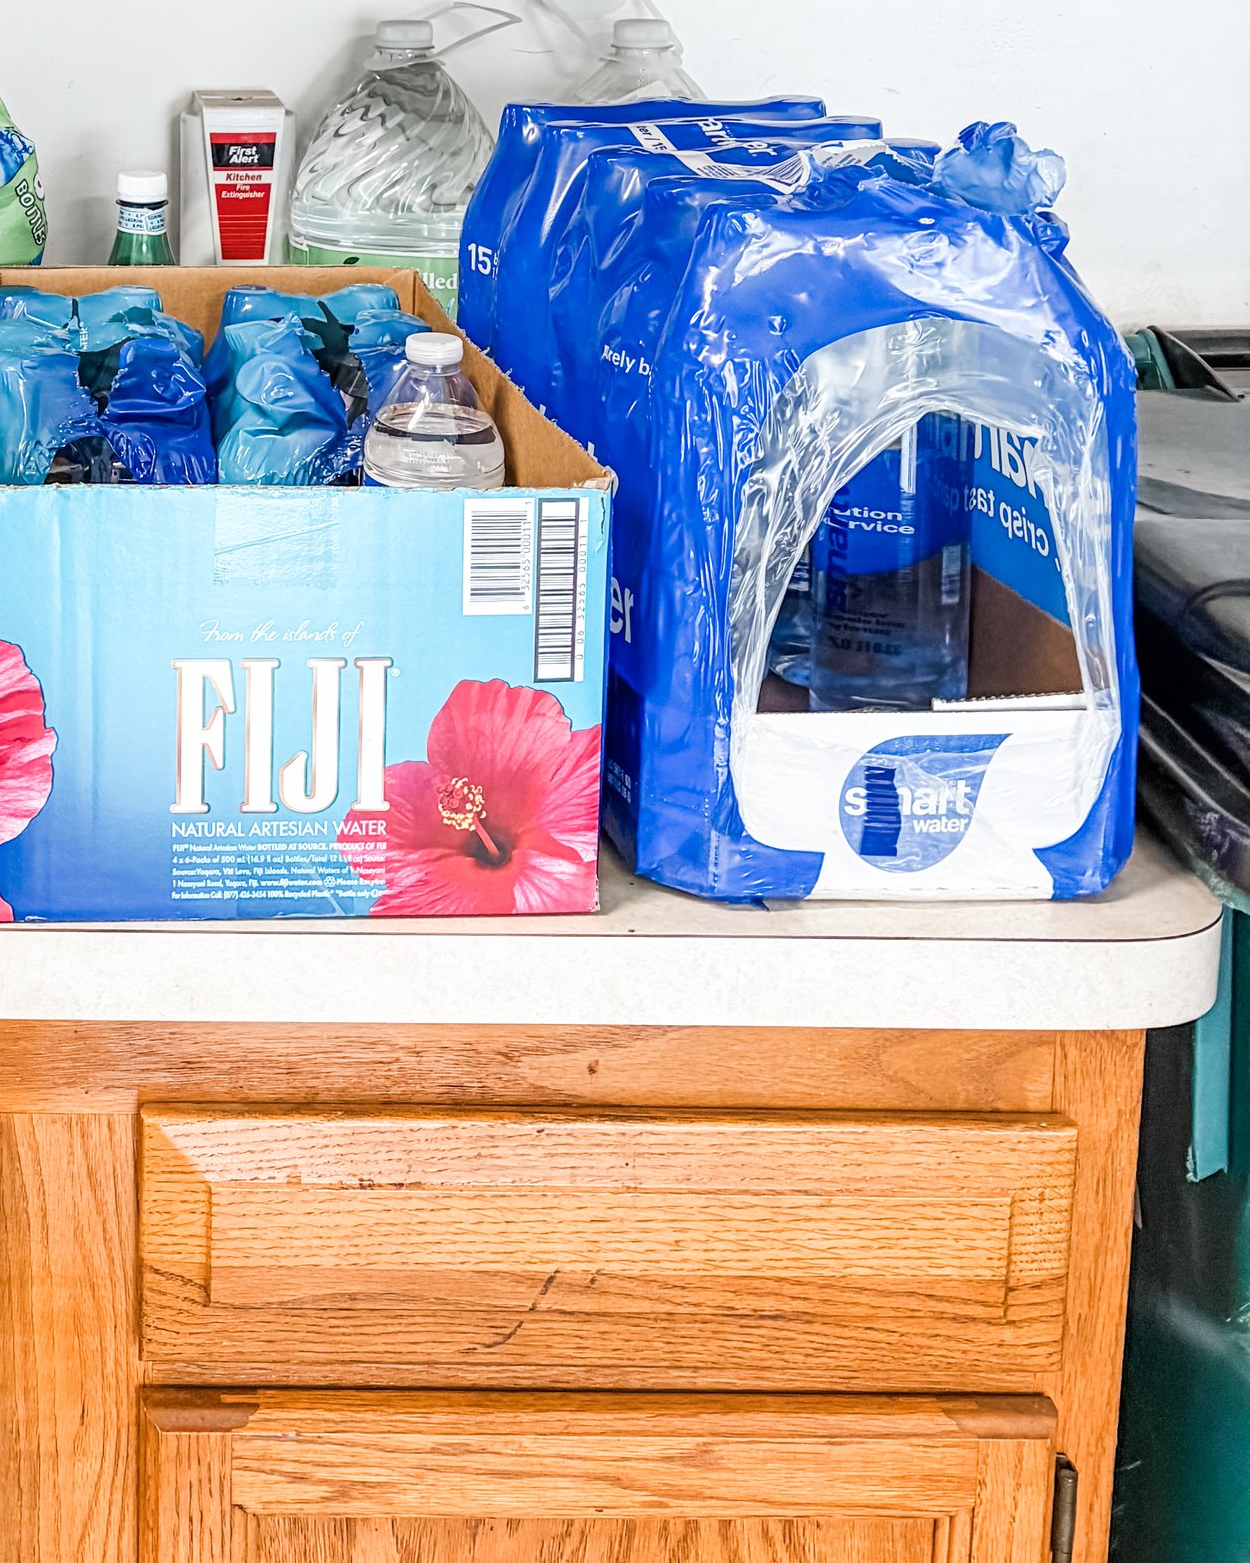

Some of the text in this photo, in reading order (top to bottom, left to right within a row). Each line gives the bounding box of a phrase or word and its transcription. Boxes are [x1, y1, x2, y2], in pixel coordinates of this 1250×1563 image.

[229, 146, 257, 156] First
[229, 154, 260, 164] Alert
[226, 173, 262, 182] Kitchen
[222, 191, 265, 199] Extinguisher
[14, 179, 48, 247] BOTTLES
[467, 242, 492, 275] 15
[199, 619, 365, 647] From the islands of
[170, 657, 394, 814] FIJI
[171, 820, 387, 837] NATURAL ARTESIAN WATER
[913, 818, 969, 832] water
